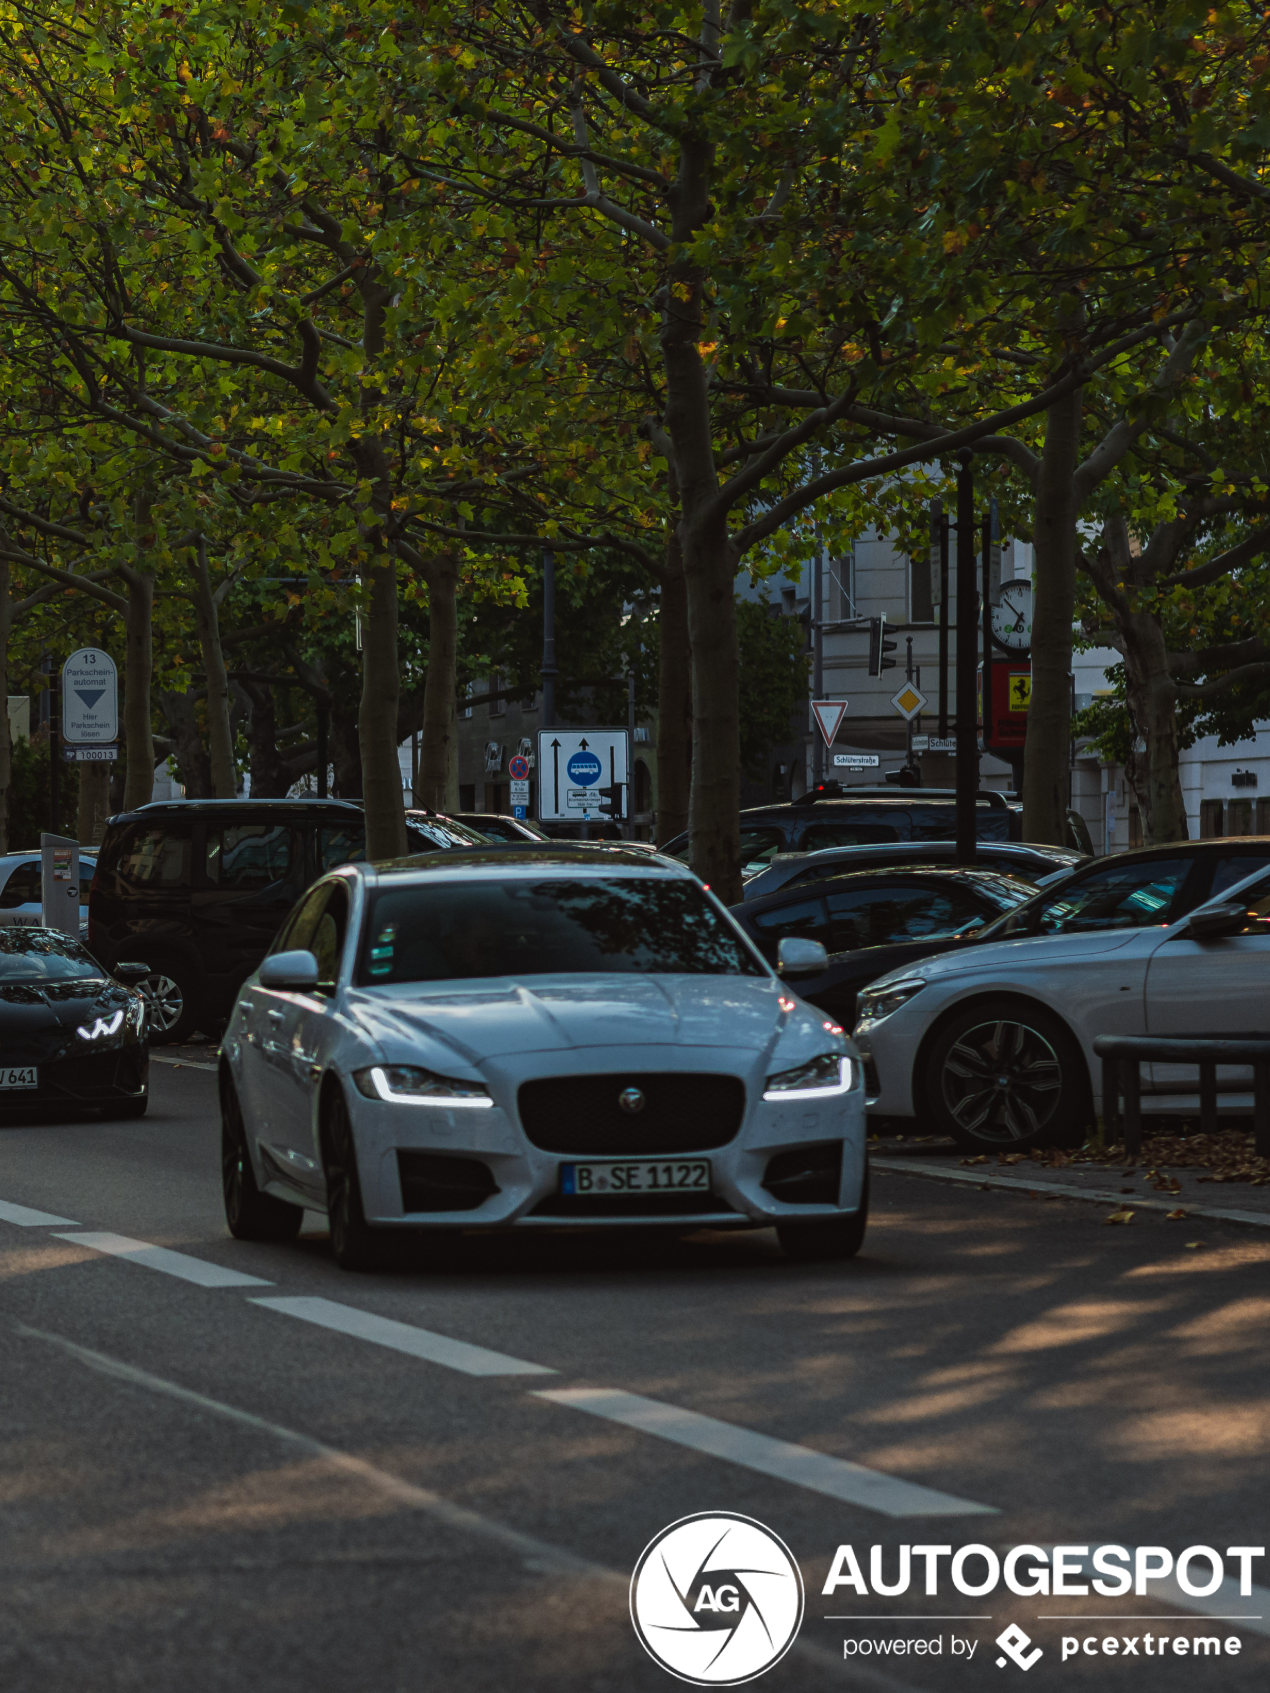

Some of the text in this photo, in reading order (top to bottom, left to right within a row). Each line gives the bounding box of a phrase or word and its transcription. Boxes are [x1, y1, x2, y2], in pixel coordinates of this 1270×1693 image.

[83, 654, 96, 664] 13
[73, 678, 106, 686] automat
[83, 713, 98, 721] Hier
[80, 730, 100, 738] lösen
[930, 738, 957, 747] Schlüte
[82, 751, 113, 759] 100013
[836, 756, 876, 764] Schlüterstraße
[13, 917, 40, 926] WA
[8, 1069, 36, 1084] 641
[578, 1164, 707, 1191] B SE 1122
